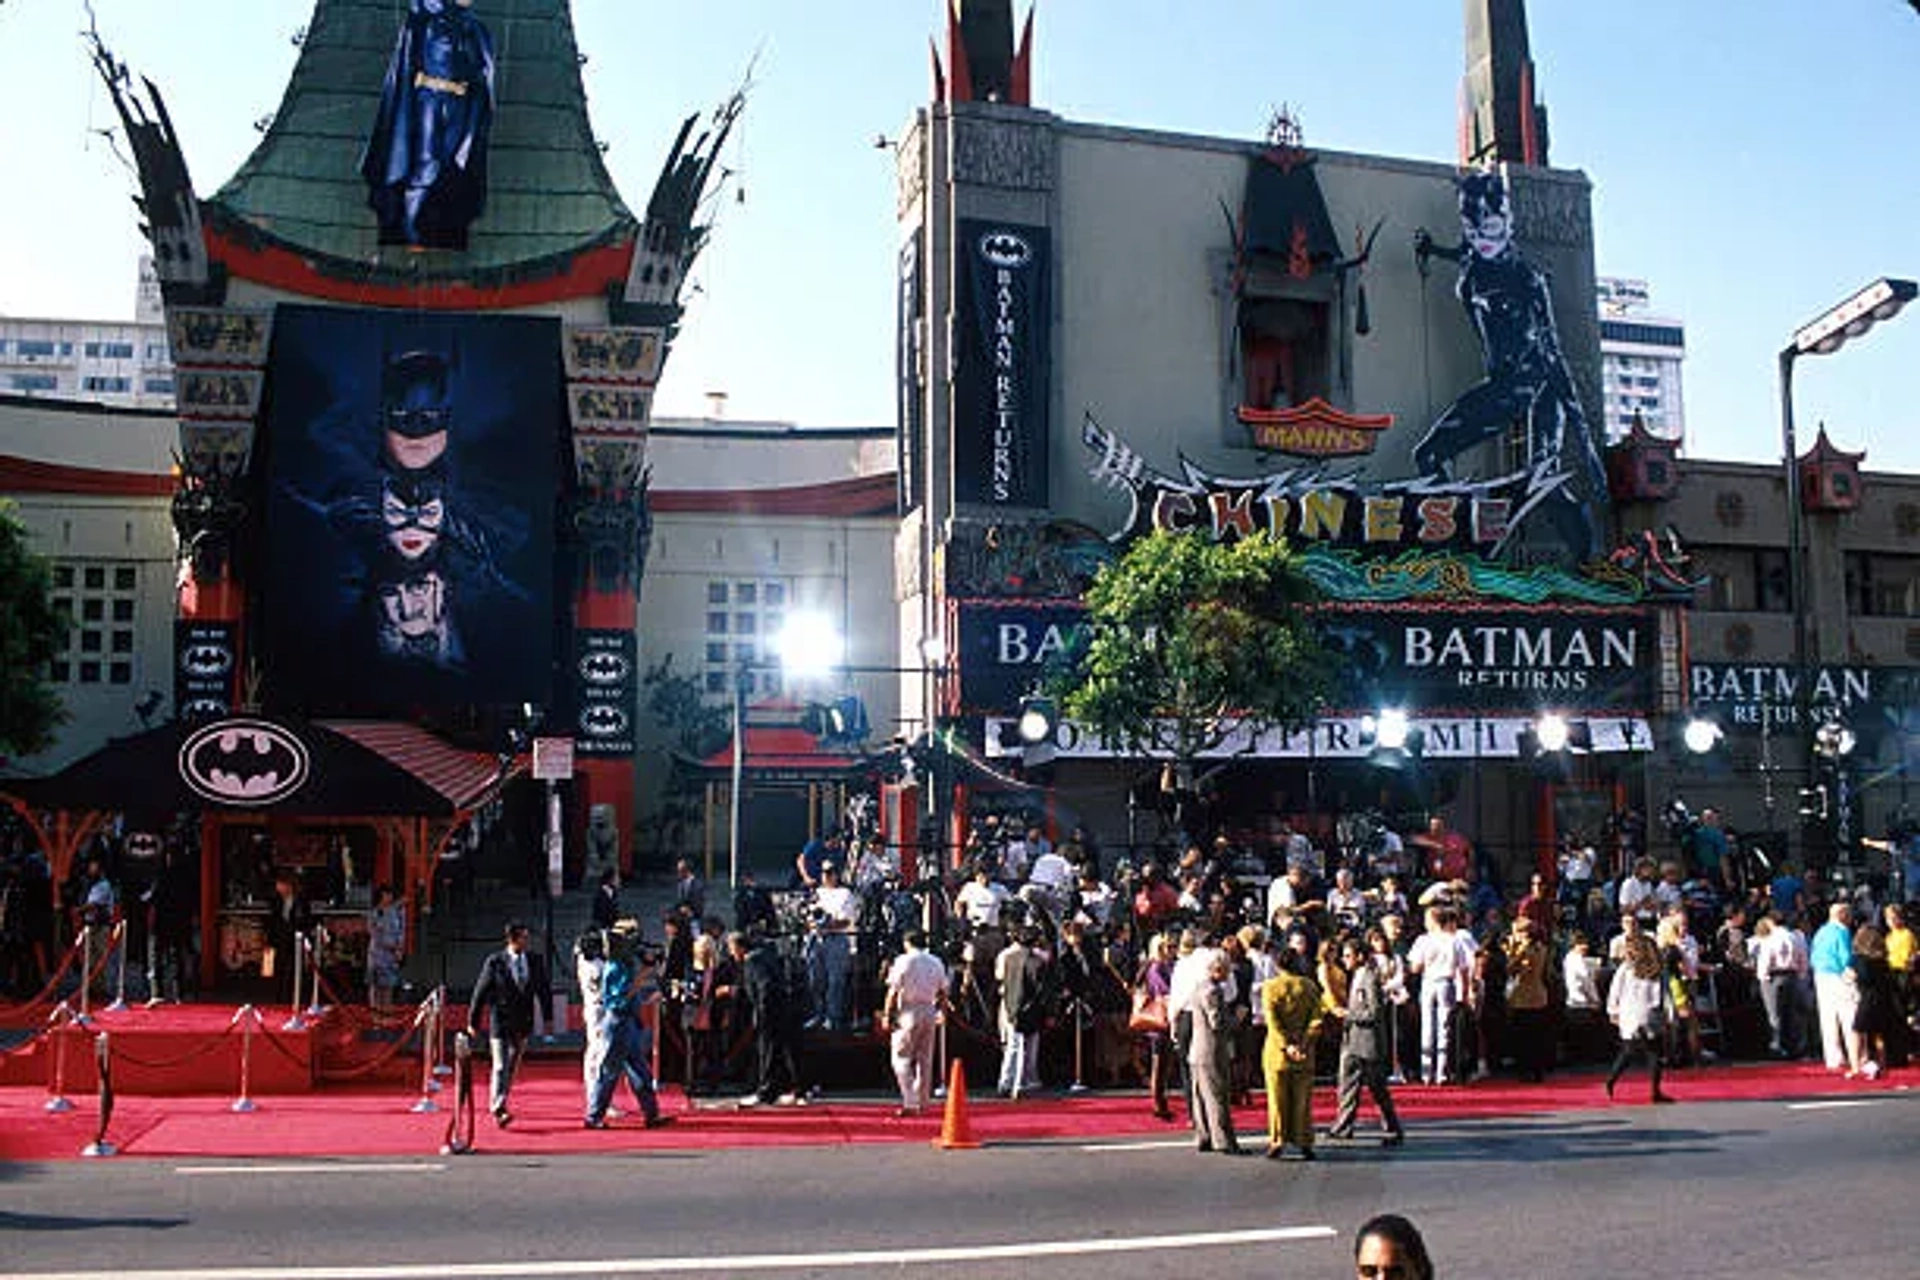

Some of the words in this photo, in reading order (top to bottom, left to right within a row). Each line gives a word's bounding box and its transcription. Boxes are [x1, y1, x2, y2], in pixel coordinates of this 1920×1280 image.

[996, 268, 1013, 367] BATMAN
[994, 375, 1013, 500] RETURNS
[1264, 423, 1367, 450] MANN'S
[1153, 487, 1513, 542] CHINESE
[1404, 626, 1637, 668] BATMAN
[1457, 670, 1588, 690] RETURNS
[1692, 666, 1871, 701] BATMAN
